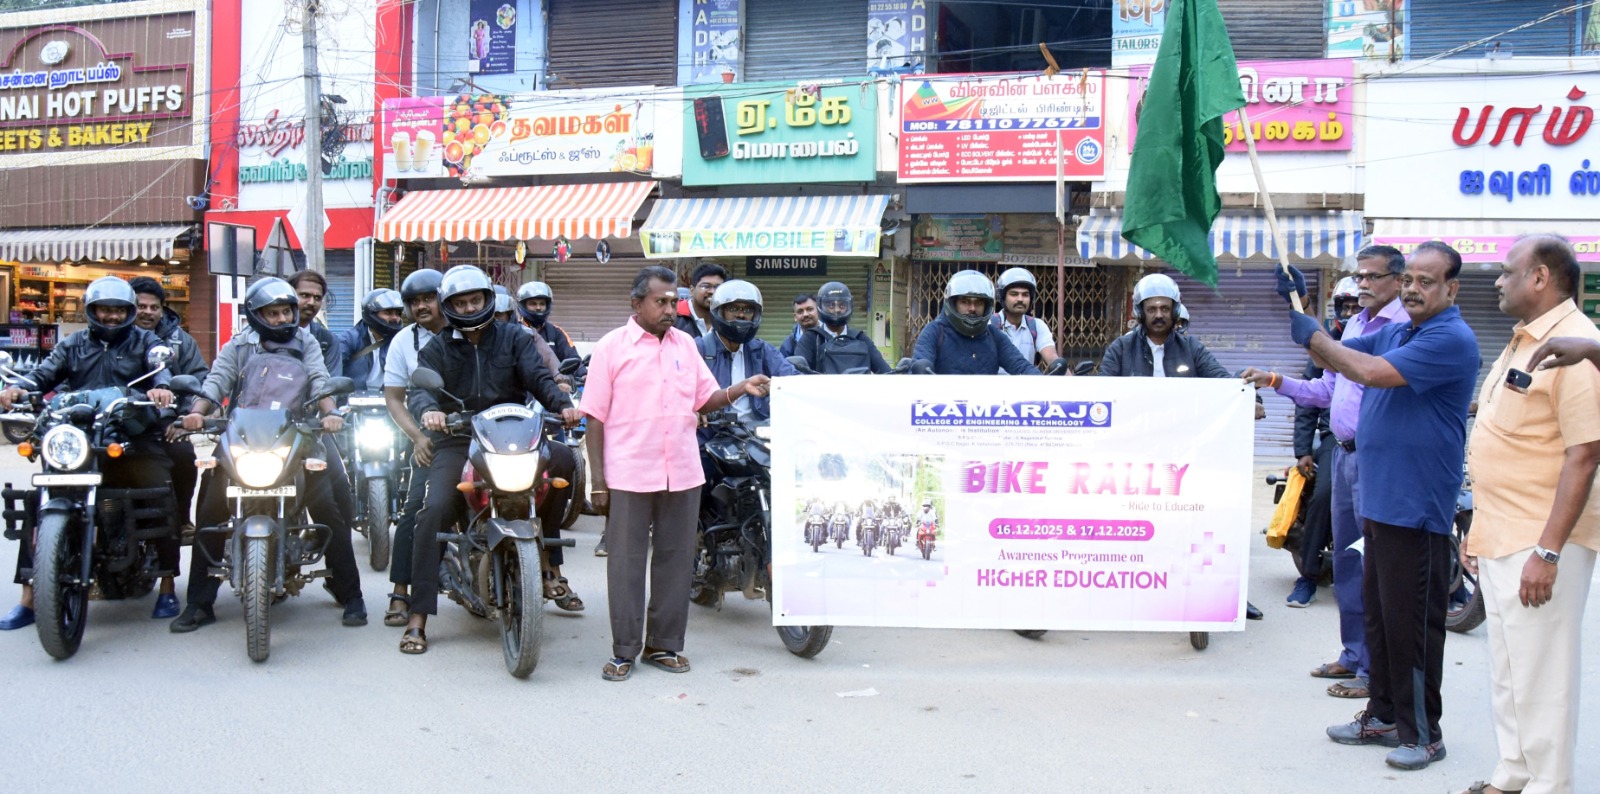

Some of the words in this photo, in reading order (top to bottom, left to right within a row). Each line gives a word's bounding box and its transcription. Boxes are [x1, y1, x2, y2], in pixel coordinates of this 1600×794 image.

[1117, 38, 1159, 50] TAILORS
[51, 70, 84, 88] ஹாட்
[88, 64, 120, 81] பப்ஸ்
[47, 90, 96, 118] HOT
[104, 84, 182, 115] PUFFS
[979, 102, 1029, 117] டிஜிட்டல்
[509, 104, 632, 145] தவமகள்
[909, 121, 938, 132] MOB:
[945, 118, 1014, 131] 78110
[1018, 116, 1086, 129] 77677
[1451, 85, 1594, 147] பாம்
[47, 127, 63, 148] &
[68, 122, 152, 147] BAKERY
[733, 131, 859, 160] மொபைல்
[559, 151, 566, 161] &
[1459, 163, 1552, 202] ஜவுளி
[689, 230, 825, 252] A.K.MOBILE
[755, 257, 817, 270] SAMSUNG
[914, 403, 1088, 418] KAMARAJ
[960, 461, 1048, 494] BIKE
[1071, 462, 1190, 497] RALLY
[1128, 501, 1149, 512] Ride
[1152, 501, 1162, 512] to
[1165, 502, 1204, 512] Educate
[996, 523, 1063, 536] 16.12.2025
[1066, 525, 1077, 536] &
[1080, 525, 1146, 537] 17.12.2025
[998, 549, 1058, 562] Awareness
[1061, 549, 1128, 565] Programme
[1130, 553, 1144, 563] on
[977, 568, 1048, 588] HIGHER
[1054, 570, 1168, 589] EDUCATION
